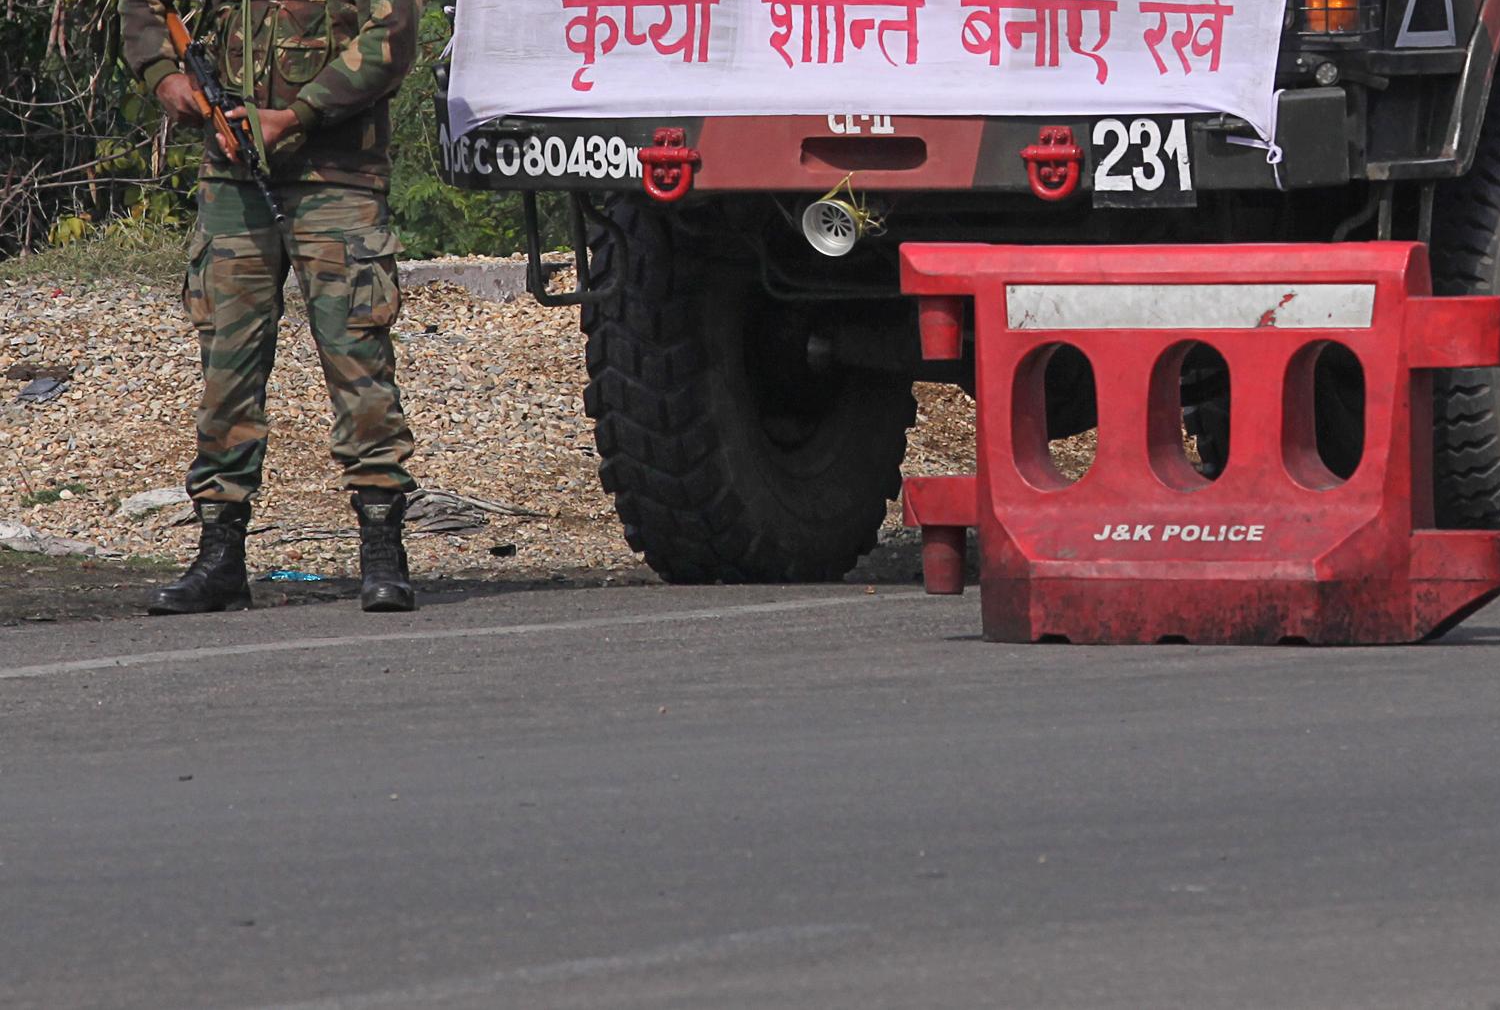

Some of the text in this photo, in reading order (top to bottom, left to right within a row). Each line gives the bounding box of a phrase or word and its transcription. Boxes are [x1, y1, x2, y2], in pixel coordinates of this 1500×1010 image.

[1091, 118, 1193, 192] 231
[1093, 524, 1266, 542] J&K POLICE
